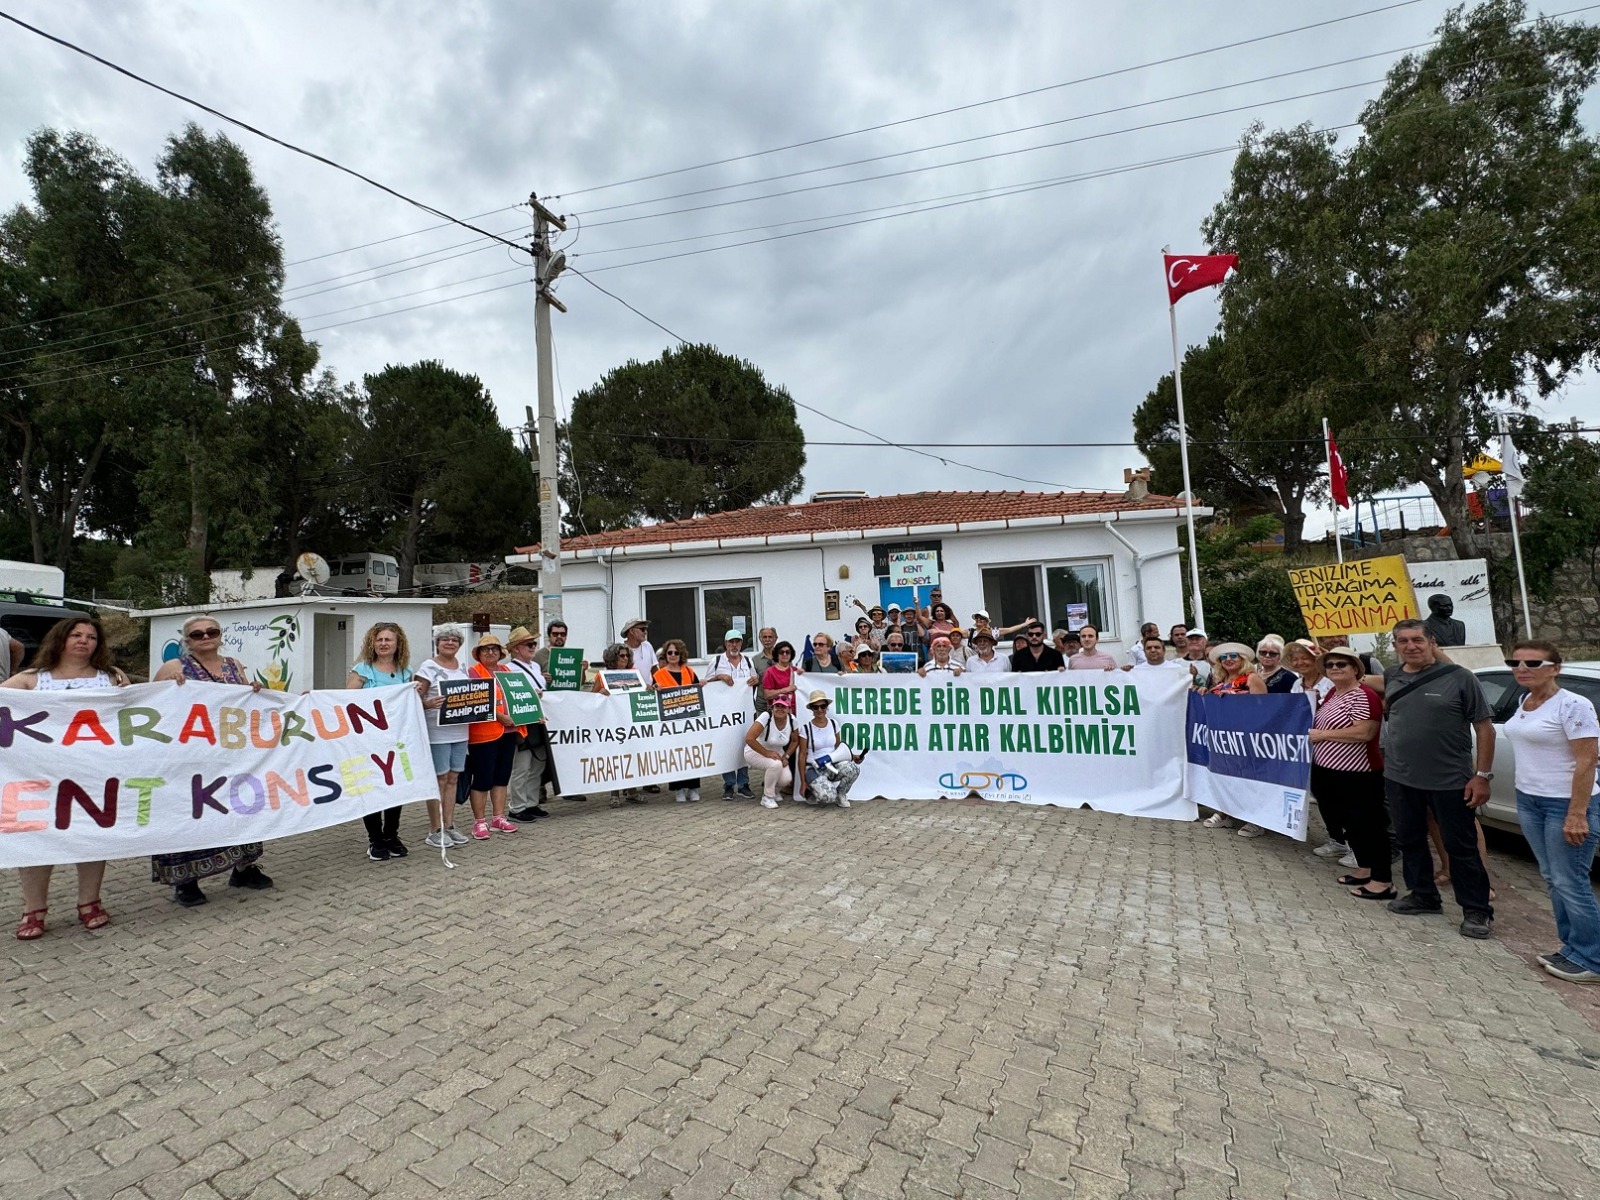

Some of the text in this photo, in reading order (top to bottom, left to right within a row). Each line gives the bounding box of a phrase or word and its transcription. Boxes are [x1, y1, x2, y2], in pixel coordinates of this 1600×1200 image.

[891, 552, 935, 562] KARABURUN
[897, 576, 931, 586] KONSEYİ
[223, 634, 244, 653] Köy
[558, 654, 575, 664] İzmir
[555, 669, 576, 678] Yaşam
[447, 682, 490, 694] HAYDİ İZMİR
[448, 691, 490, 703] GELECEĞİNE
[511, 692, 532, 701] Yaşam
[835, 682, 1141, 715] NEREDE BİR DAL KIRILSA
[446, 704, 490, 718] SAHİP ÇIK!
[513, 704, 538, 714] Alanları
[0, 699, 389, 749] KARABURUN
[595, 724, 655, 745] YAŞAM
[660, 711, 746, 736] ALANLARI
[840, 717, 1137, 756] ORADA ATAR KALBİMİZ!
[1210, 729, 1248, 757] KENT
[580, 742, 716, 785] TARAFIZ MUHATABIZ
[191, 741, 413, 820] KONSEYİ
